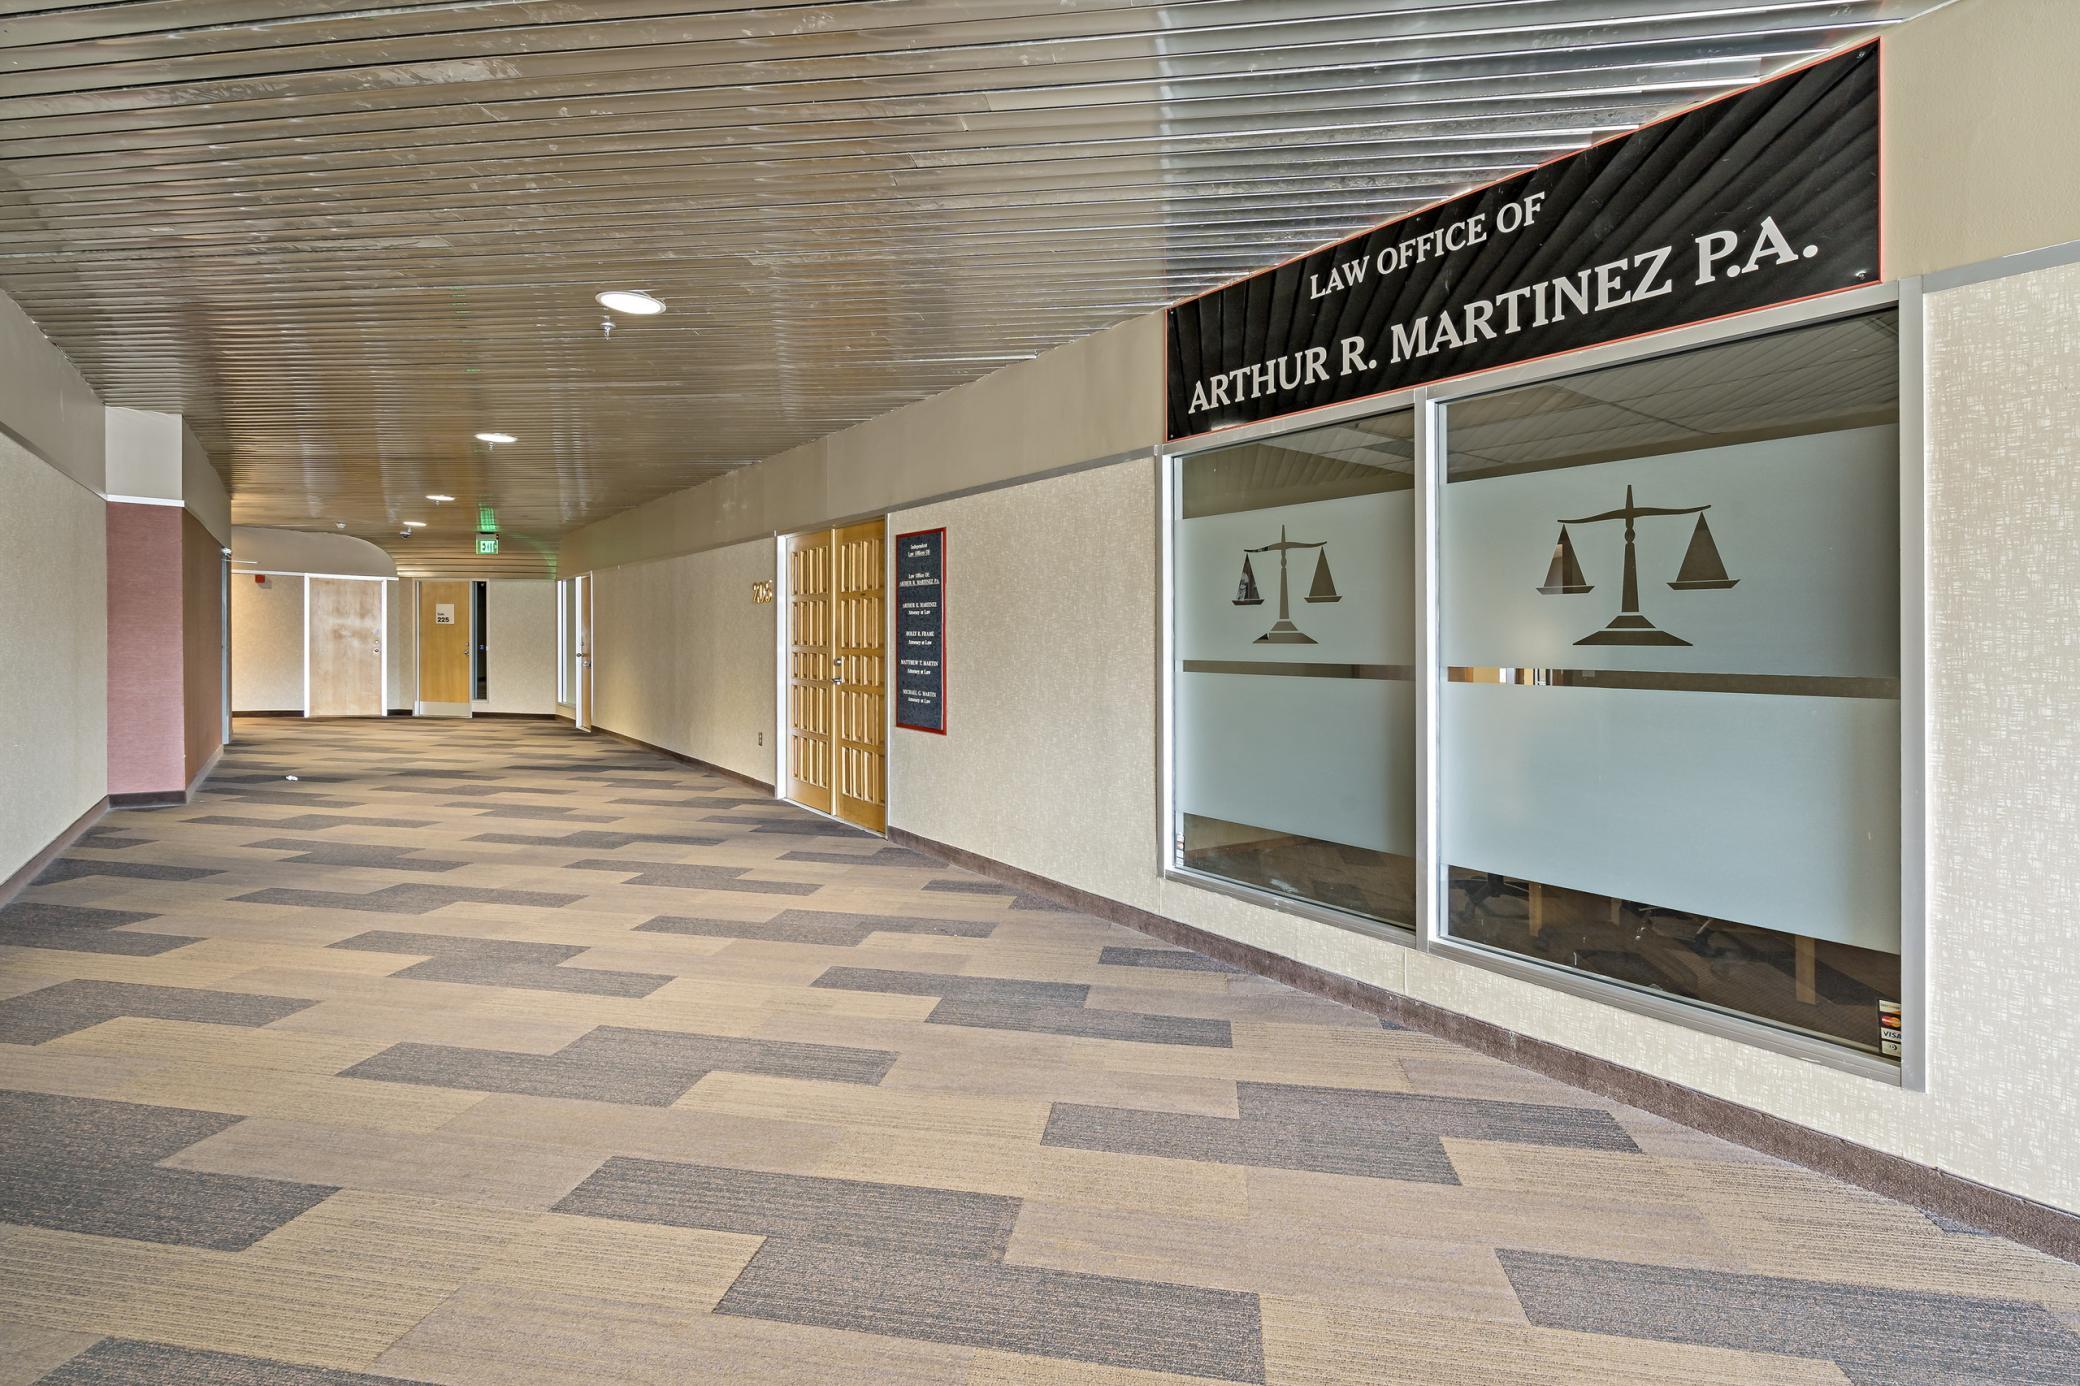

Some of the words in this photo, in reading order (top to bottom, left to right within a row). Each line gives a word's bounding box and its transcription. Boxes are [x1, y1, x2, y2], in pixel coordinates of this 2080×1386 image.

[1310, 255, 1370, 300] LAW
[1376, 213, 1487, 275] OFFICE
[1496, 191, 1546, 233] OF
[1188, 346, 1330, 415] ARTHUR
[1340, 335, 1378, 376] R.
[1390, 245, 1673, 364] MARTINEZ
[1694, 215, 1819, 286] P.A.
[1883, 1030, 1901, 1039] VISA
